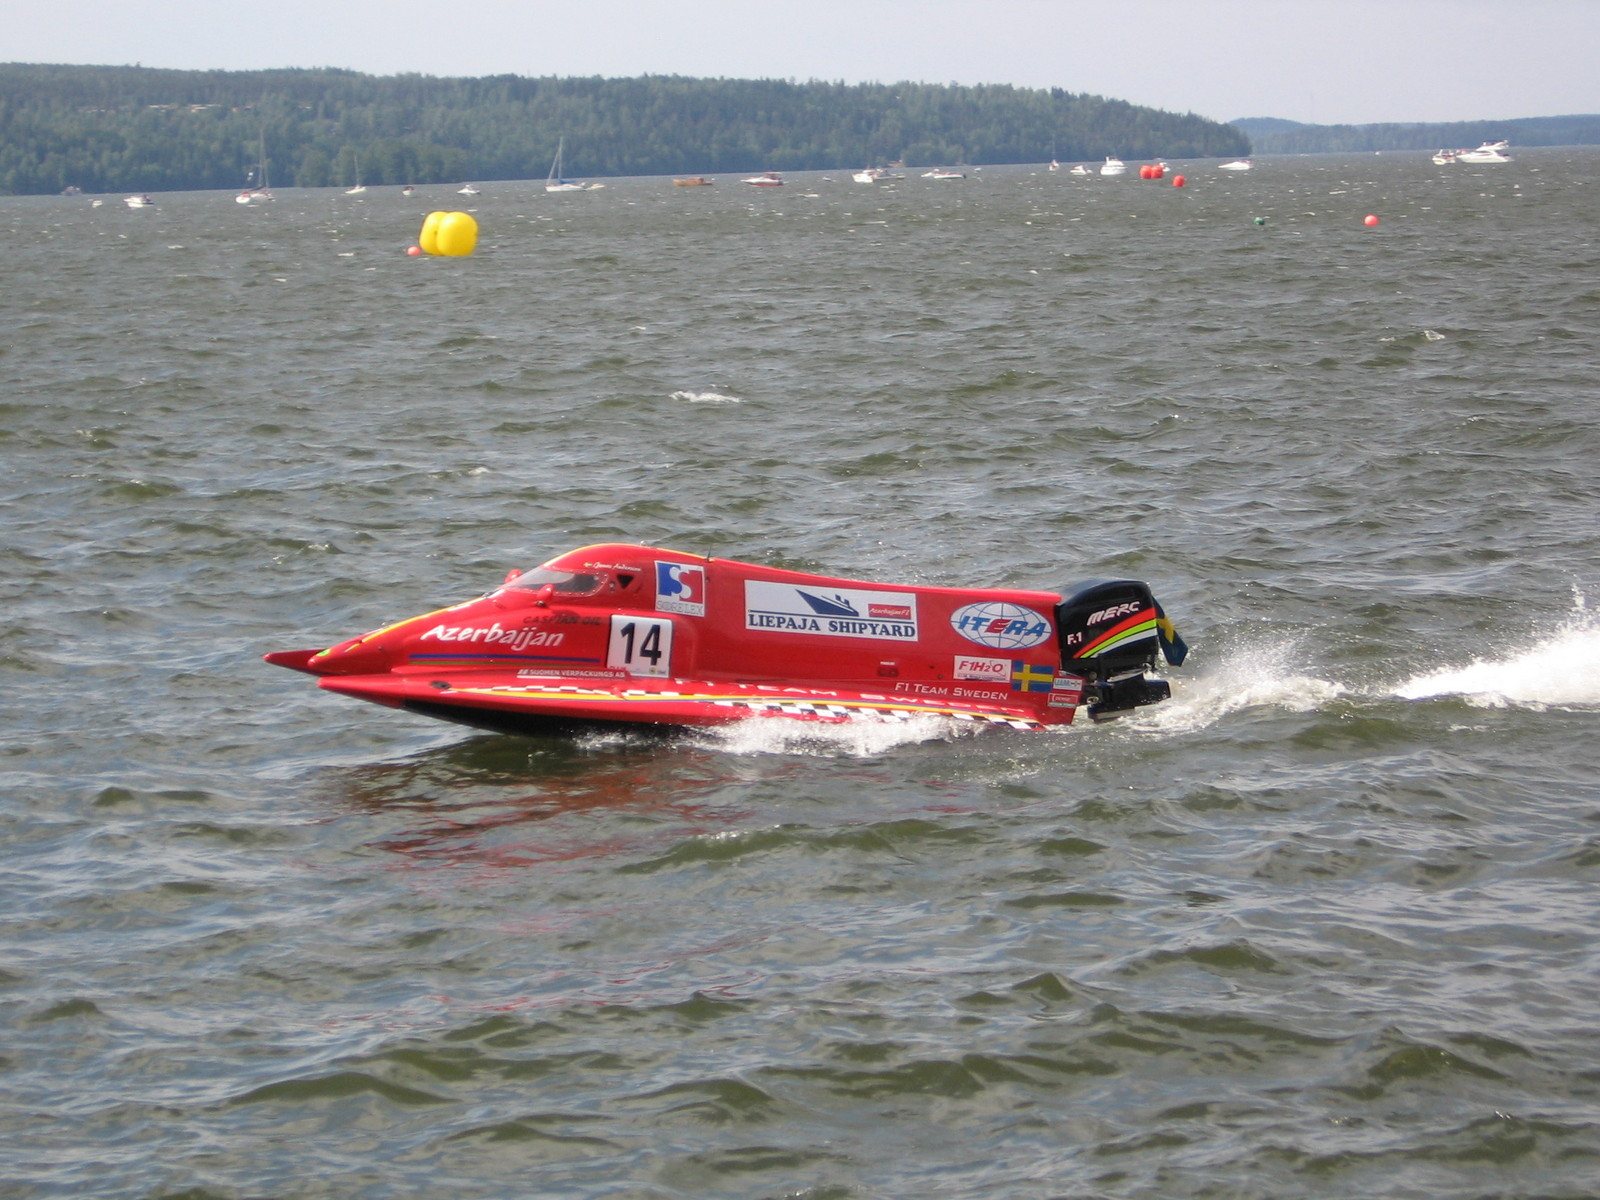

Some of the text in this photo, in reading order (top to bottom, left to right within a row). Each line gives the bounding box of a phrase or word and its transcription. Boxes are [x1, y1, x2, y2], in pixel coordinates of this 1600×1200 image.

[748, 614, 916, 637] LIEPAJA SHIPYARD
[1086, 601, 1140, 626] MERC
[420, 622, 564, 651] Azerbaijan
[958, 615, 1047, 637] ITERA
[621, 622, 662, 666] 14
[895, 682, 1008, 700] F1 TEAM SWEDEN
